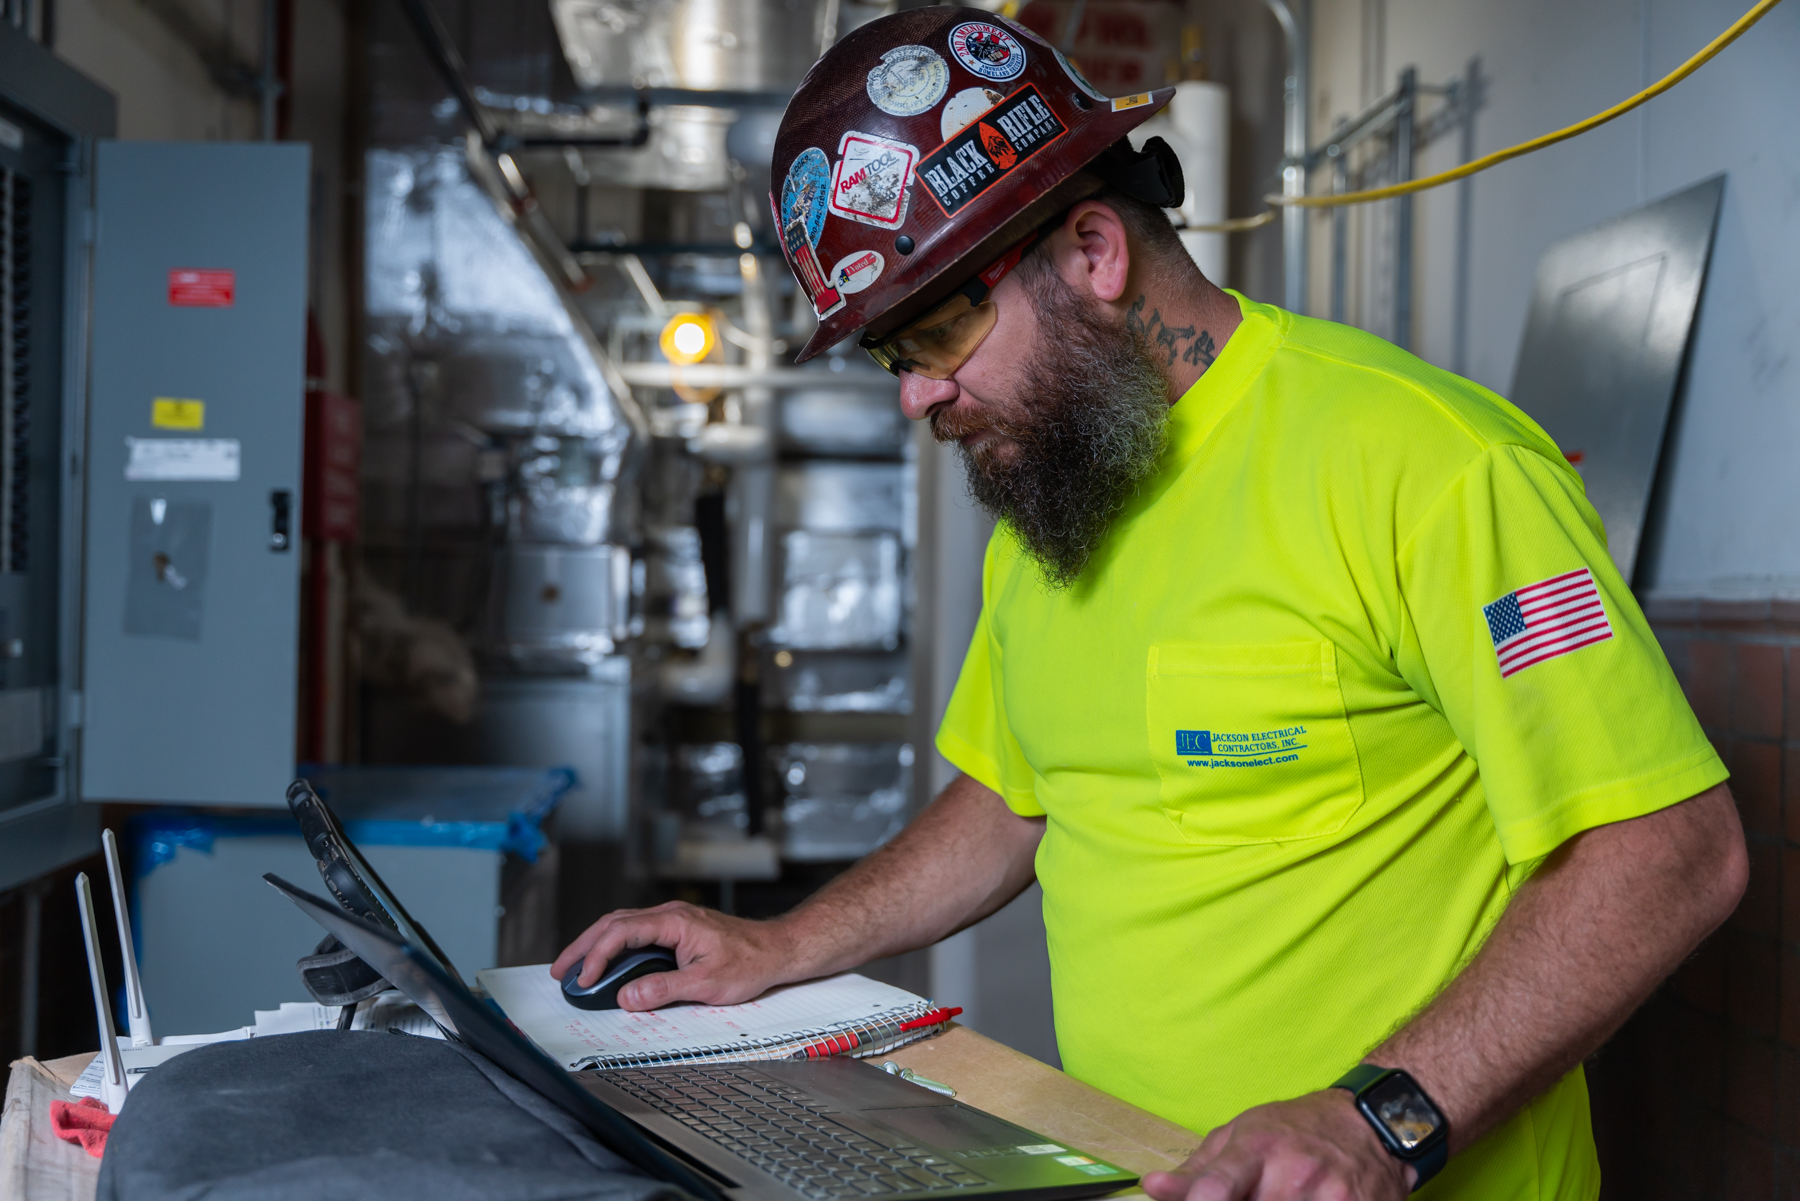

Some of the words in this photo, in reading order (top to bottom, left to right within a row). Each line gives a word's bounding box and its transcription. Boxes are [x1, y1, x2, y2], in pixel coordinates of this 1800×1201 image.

[955, 24, 1011, 42] AMENDMENT
[954, 41, 971, 57] 2ND
[924, 139, 988, 197] BLACK
[996, 94, 1051, 142] RIFLE
[942, 163, 995, 206] COFFEE
[1014, 117, 1058, 151] COMPANY
[840, 167, 867, 194] RAM
[865, 151, 897, 175] TOOL
[849, 258, 870, 273] Voted
[1178, 732, 1207, 750] JEC
[1211, 732, 1250, 743] JACKSON
[1252, 726, 1305, 741] ELECTRICAL
[1217, 740, 1280, 753] CONTRACTORS,
[1281, 737, 1300, 748] INC.
[1187, 755, 1298, 769] www.jacksonelect.com
